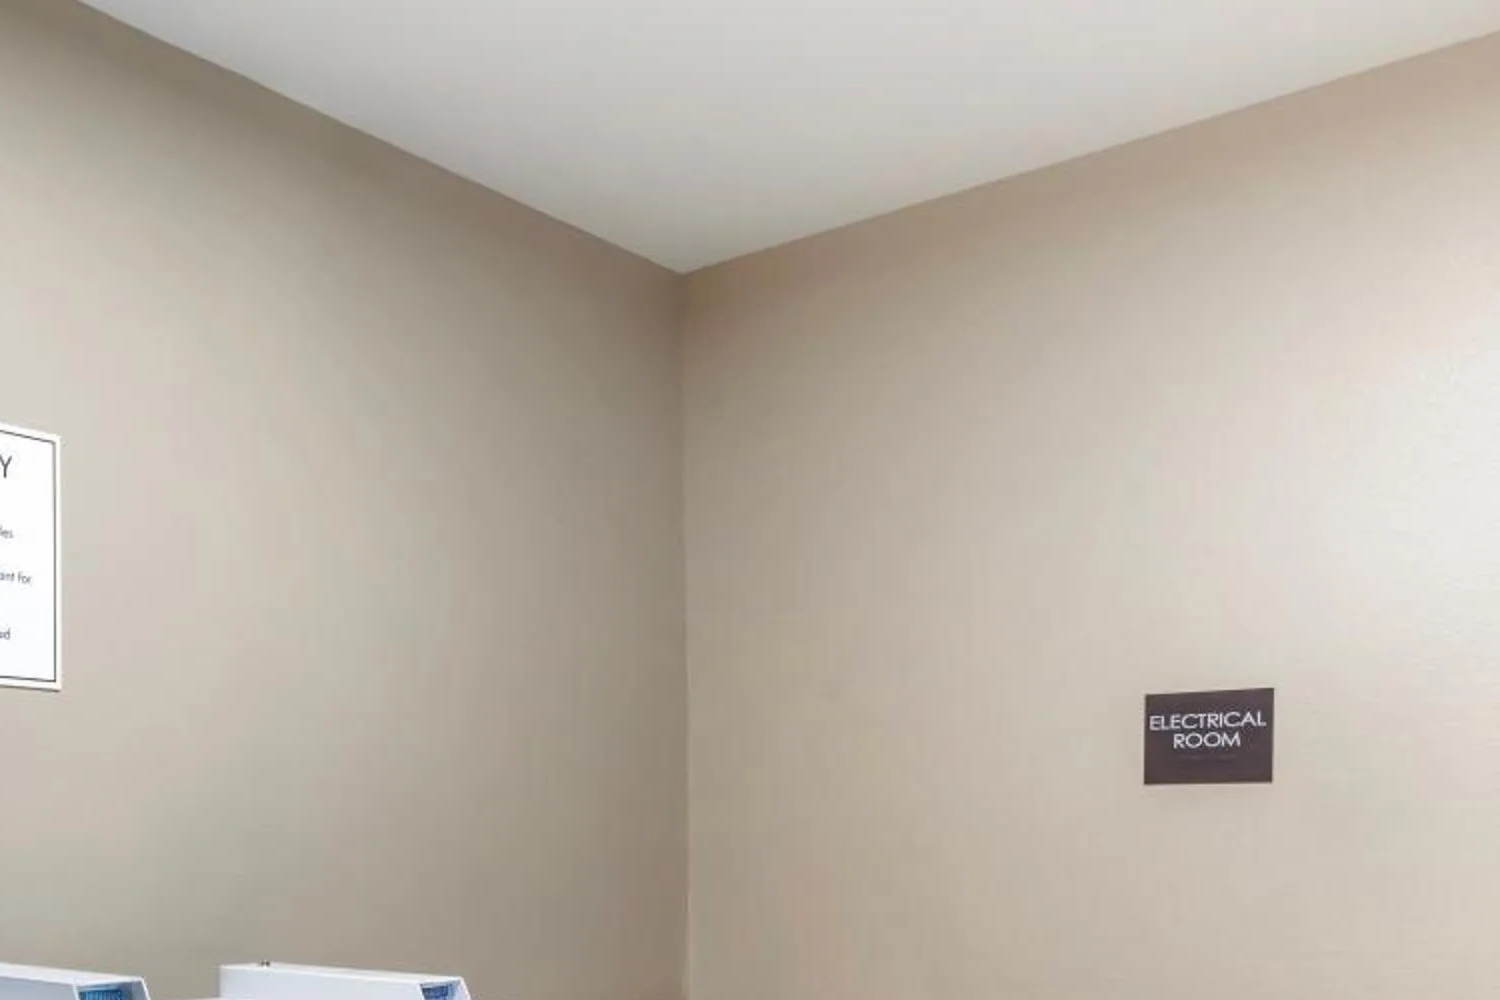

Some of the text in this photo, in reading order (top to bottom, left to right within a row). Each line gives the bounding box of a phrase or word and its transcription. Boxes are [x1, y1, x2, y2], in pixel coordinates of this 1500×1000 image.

[17, 570, 32, 585] for
[1149, 710, 1267, 731] ELECTRICAL
[1173, 732, 1241, 749] ROOM
